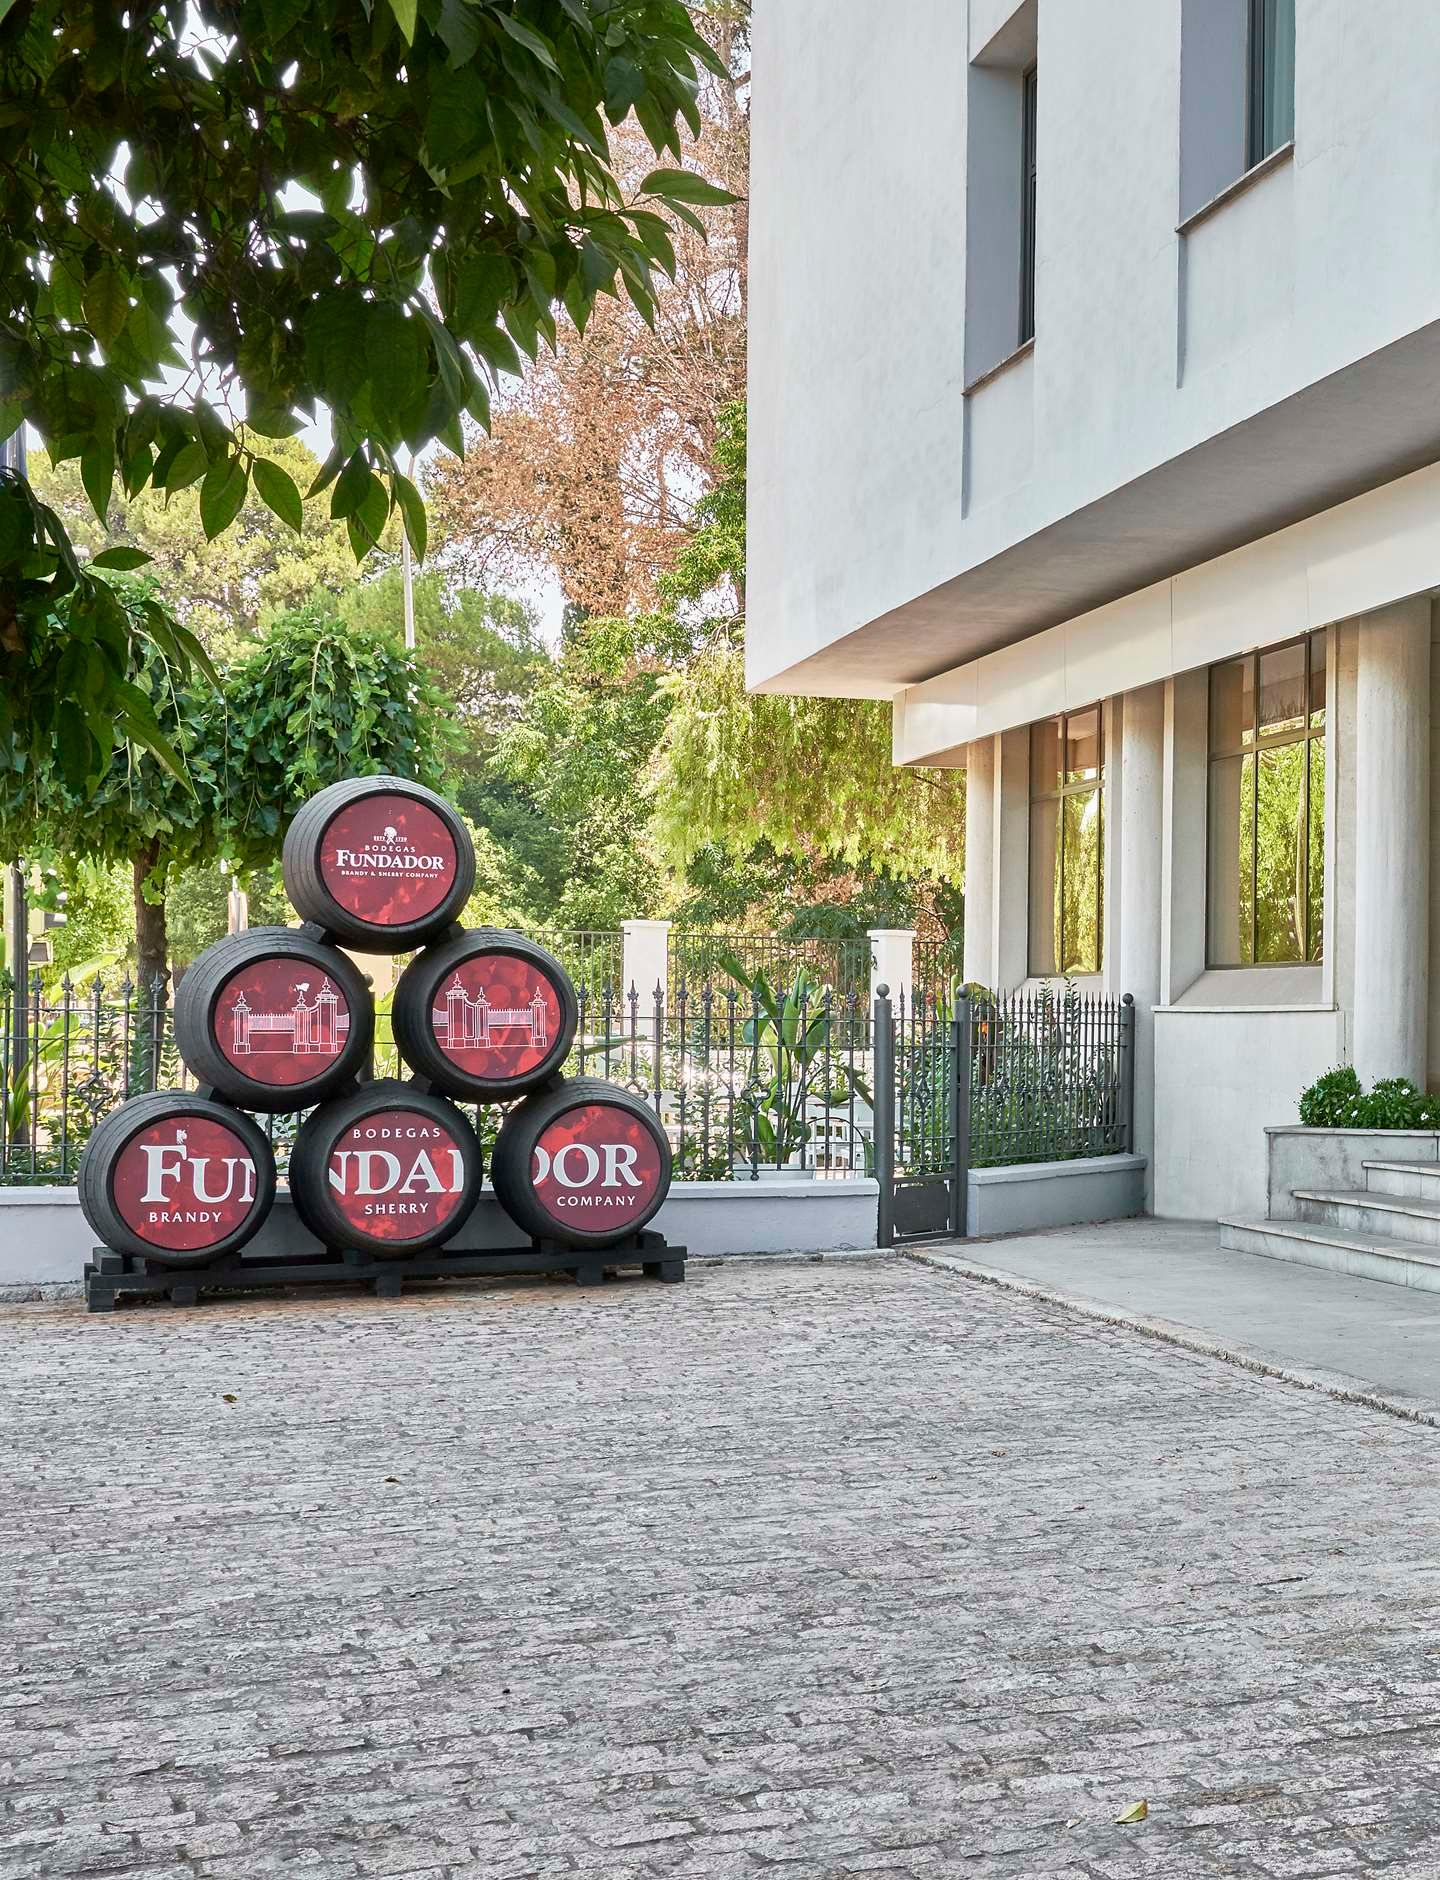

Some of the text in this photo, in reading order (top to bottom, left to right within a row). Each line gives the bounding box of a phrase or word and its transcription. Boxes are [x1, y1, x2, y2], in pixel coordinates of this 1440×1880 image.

[364, 844, 416, 853] BODEGAS
[335, 849, 445, 870] FUNDADOR
[353, 1127, 441, 1139] BODEGAS
[556, 1196, 636, 1207] COMPANY
[364, 1203, 429, 1215] SHERRY
[149, 1212, 222, 1223] BRANDY
